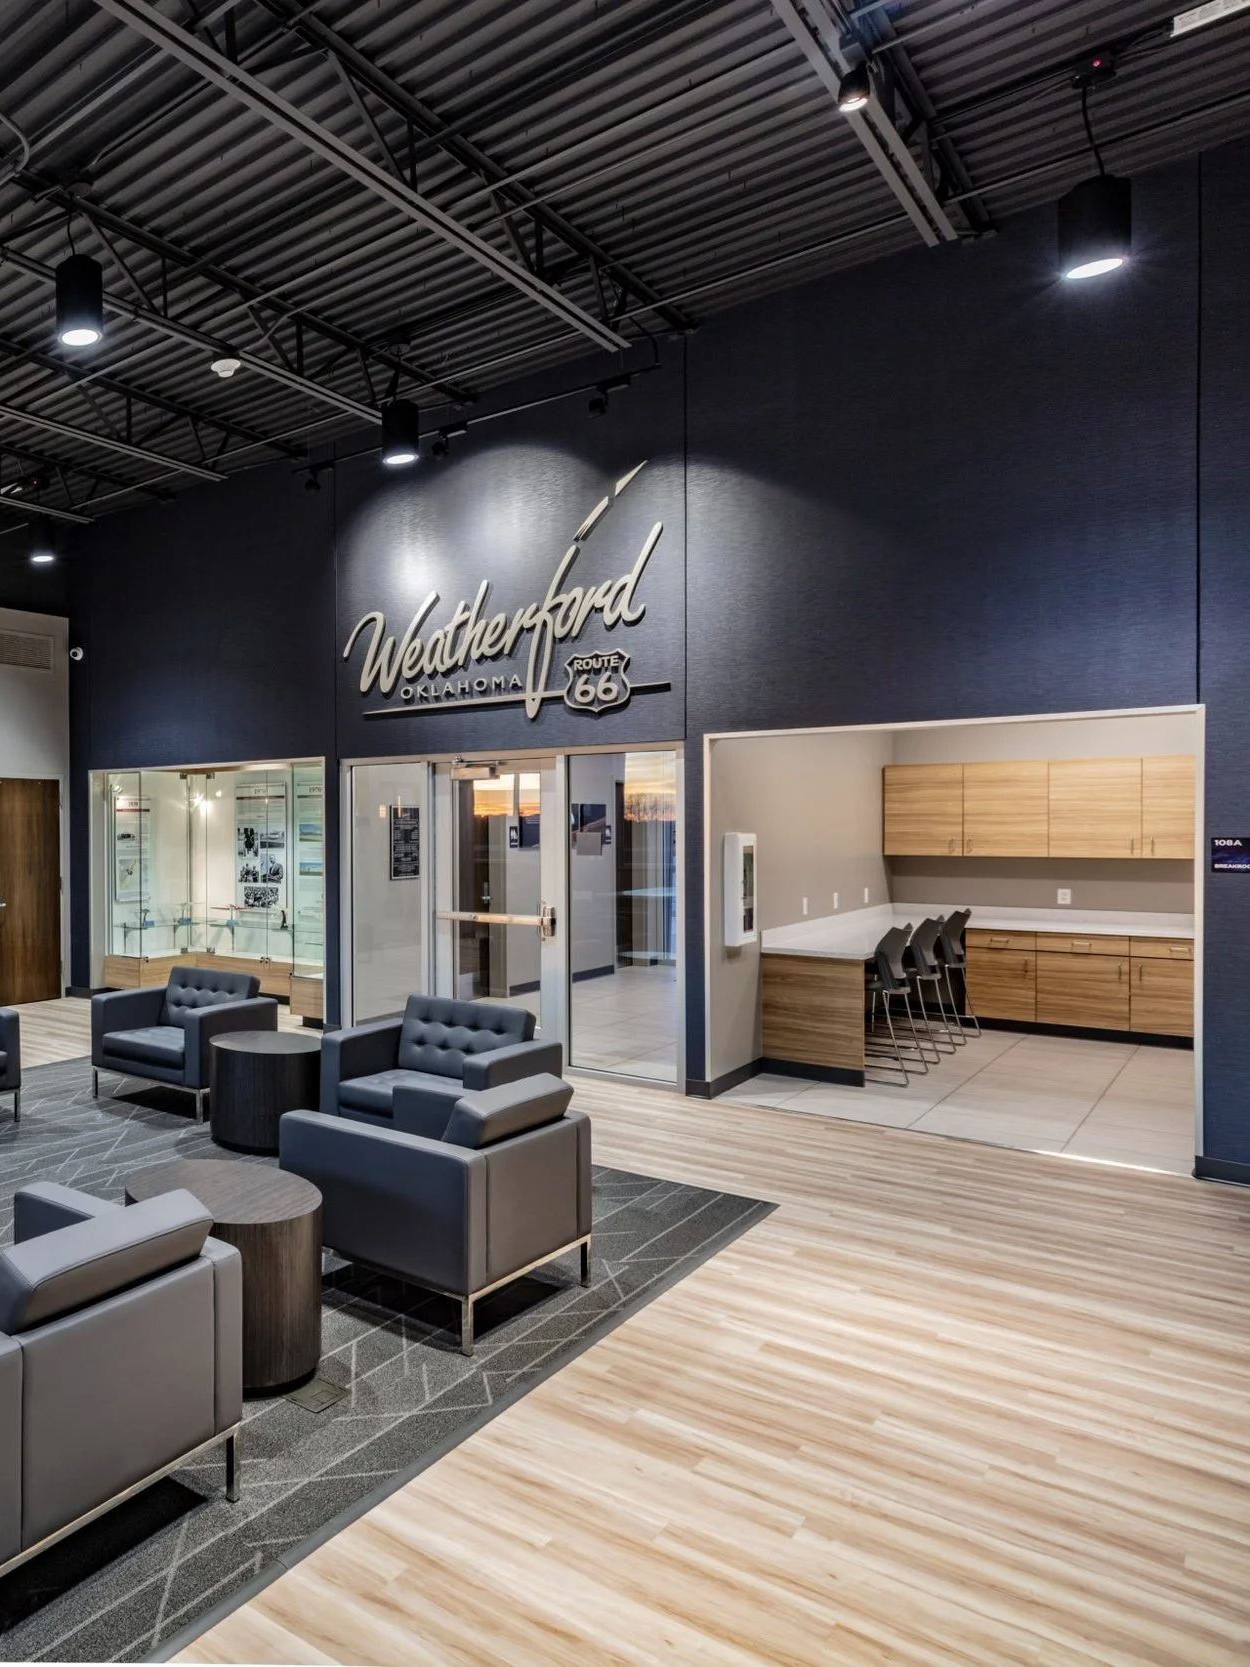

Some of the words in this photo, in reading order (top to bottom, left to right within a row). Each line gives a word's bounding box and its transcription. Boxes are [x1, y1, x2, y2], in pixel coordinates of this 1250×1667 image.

[343, 521, 663, 720] Weatherford
[573, 655, 619, 670] ROUTE
[400, 674, 523, 699] OKLAHOMA
[574, 671, 618, 703] 66
[1214, 839, 1243, 847] 108A
